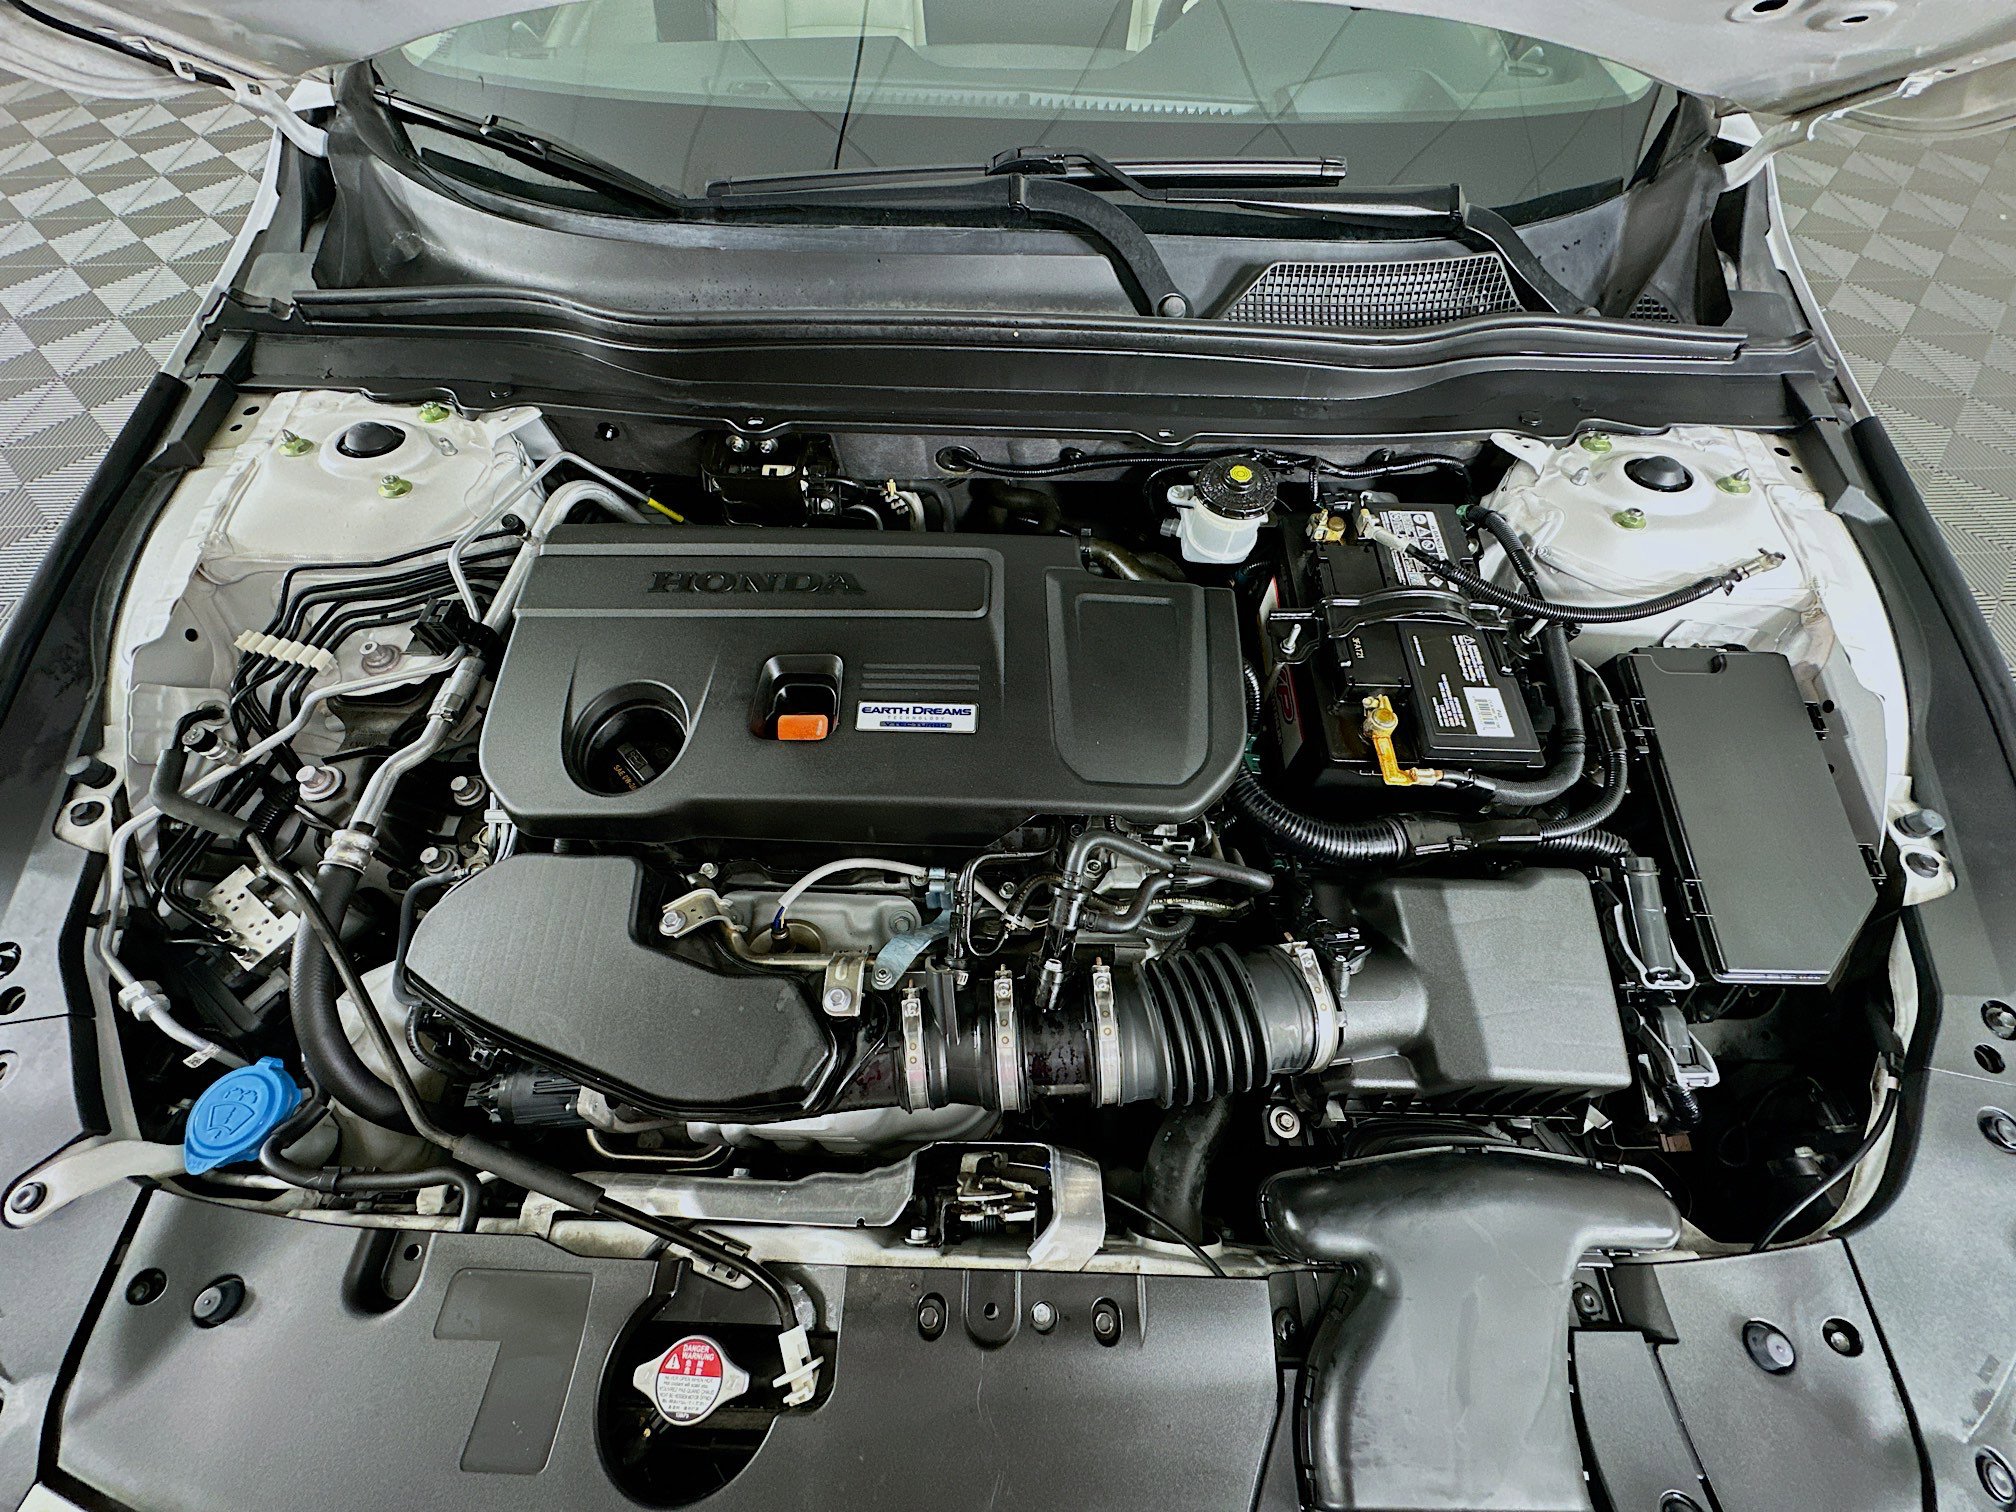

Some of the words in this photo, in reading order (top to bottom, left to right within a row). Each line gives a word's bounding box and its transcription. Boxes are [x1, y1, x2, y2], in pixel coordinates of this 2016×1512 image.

[647, 570, 866, 595] HONDA
[862, 706, 910, 714] EARTH
[912, 706, 972, 715] DREAMS
[613, 764, 626, 777] SAE
[684, 1344, 710, 1353] DANGER
